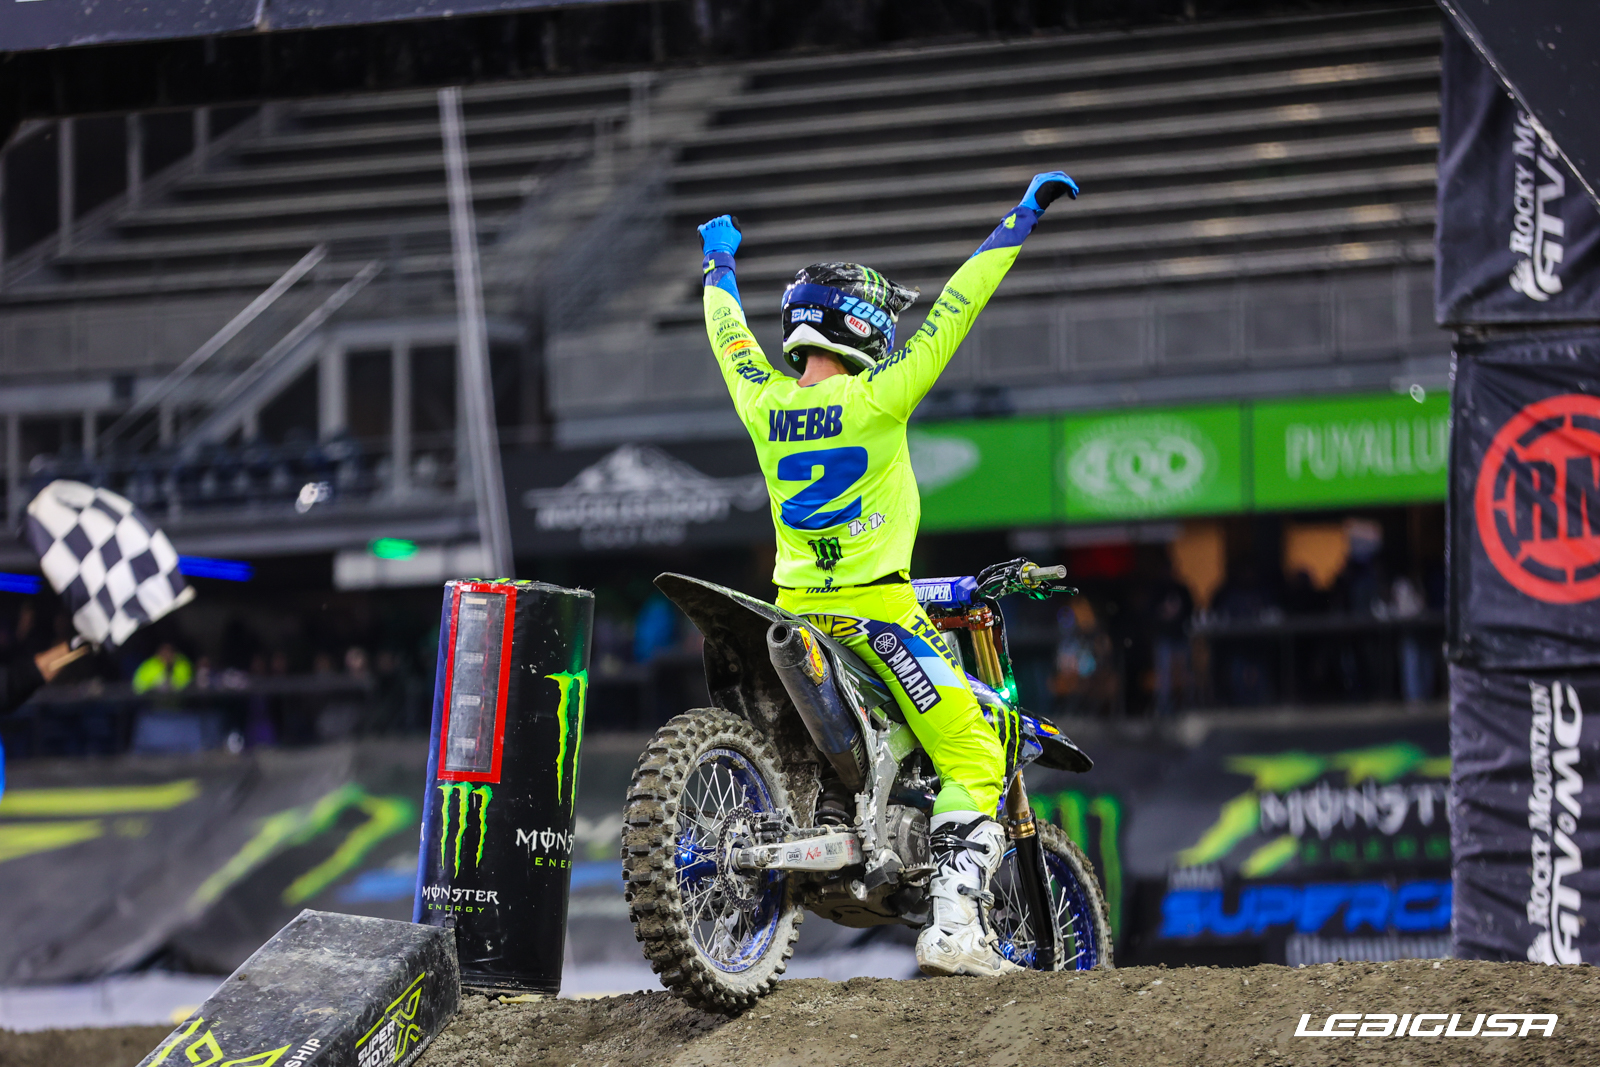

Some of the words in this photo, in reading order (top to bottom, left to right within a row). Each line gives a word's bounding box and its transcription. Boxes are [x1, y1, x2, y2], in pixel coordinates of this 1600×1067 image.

[1510, 161, 1536, 255] ROCKY
[839, 296, 893, 341] 100%
[848, 317, 867, 335] BELL
[768, 404, 843, 442] WEBB
[777, 446, 868, 530] 2
[913, 585, 950, 601] ROTAPER
[911, 614, 960, 669] THOR
[887, 645, 938, 712] YAMAHA
[421, 884, 500, 905] MONSTER
[428, 903, 484, 914] ENERGY
[357, 1019, 396, 1067] SUPER
